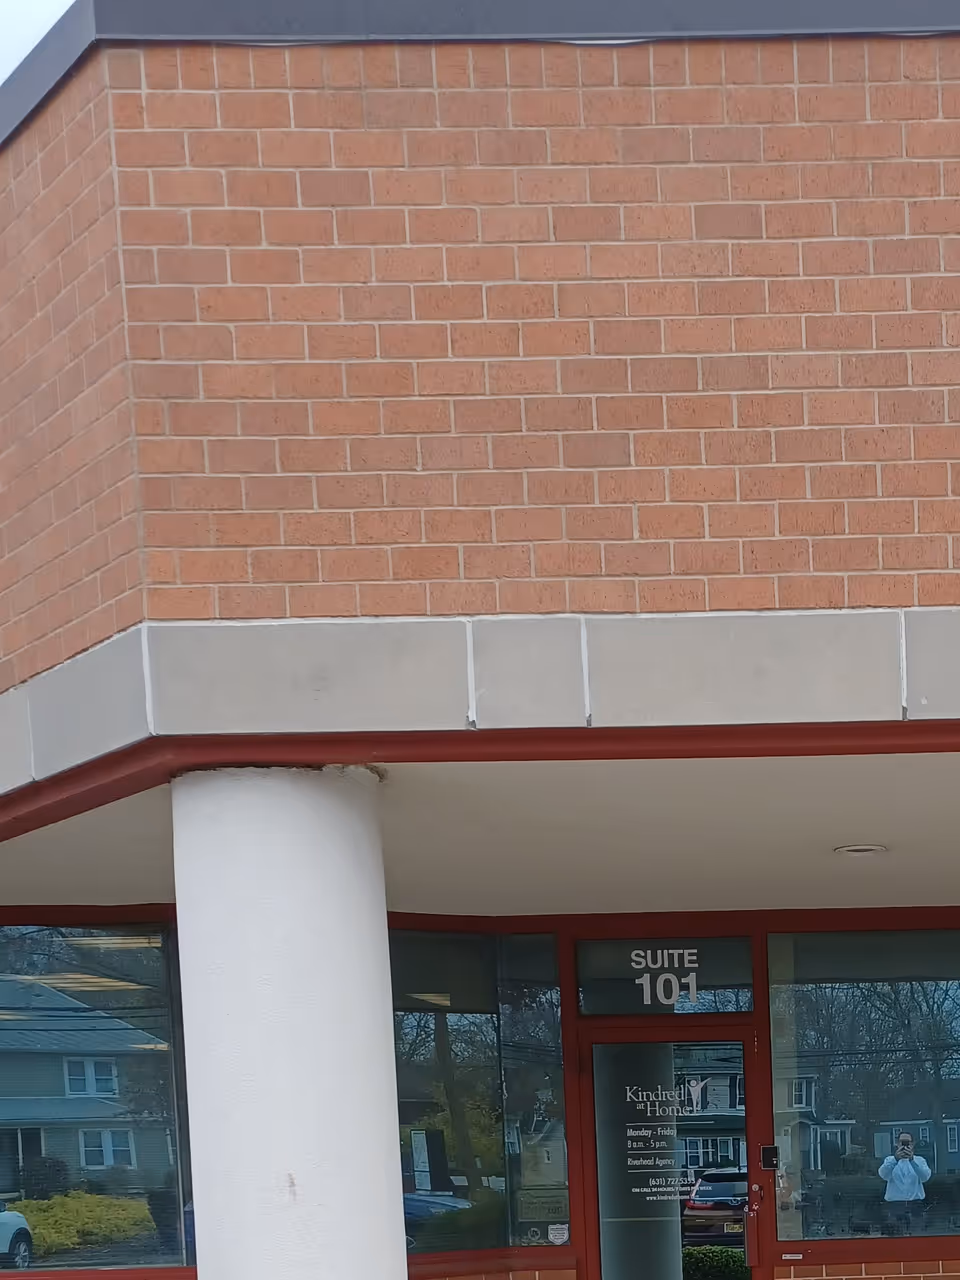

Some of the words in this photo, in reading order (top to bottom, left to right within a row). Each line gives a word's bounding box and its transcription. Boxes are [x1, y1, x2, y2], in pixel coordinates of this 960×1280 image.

[630, 948, 699, 969] SUITE
[635, 972, 698, 1005] 101
[625, 1084, 685, 1102] Kindred
[636, 1102, 645, 1110] at
[646, 1101, 691, 1117] Home
[626, 1128, 652, 1138] Monday
[657, 1127, 677, 1138] Friday
[650, 1140, 655, 1148] 5
[627, 1157, 654, 1166] Riverhead
[655, 1157, 675, 1167] Agency
[649, 1177, 666, 1186] (631)
